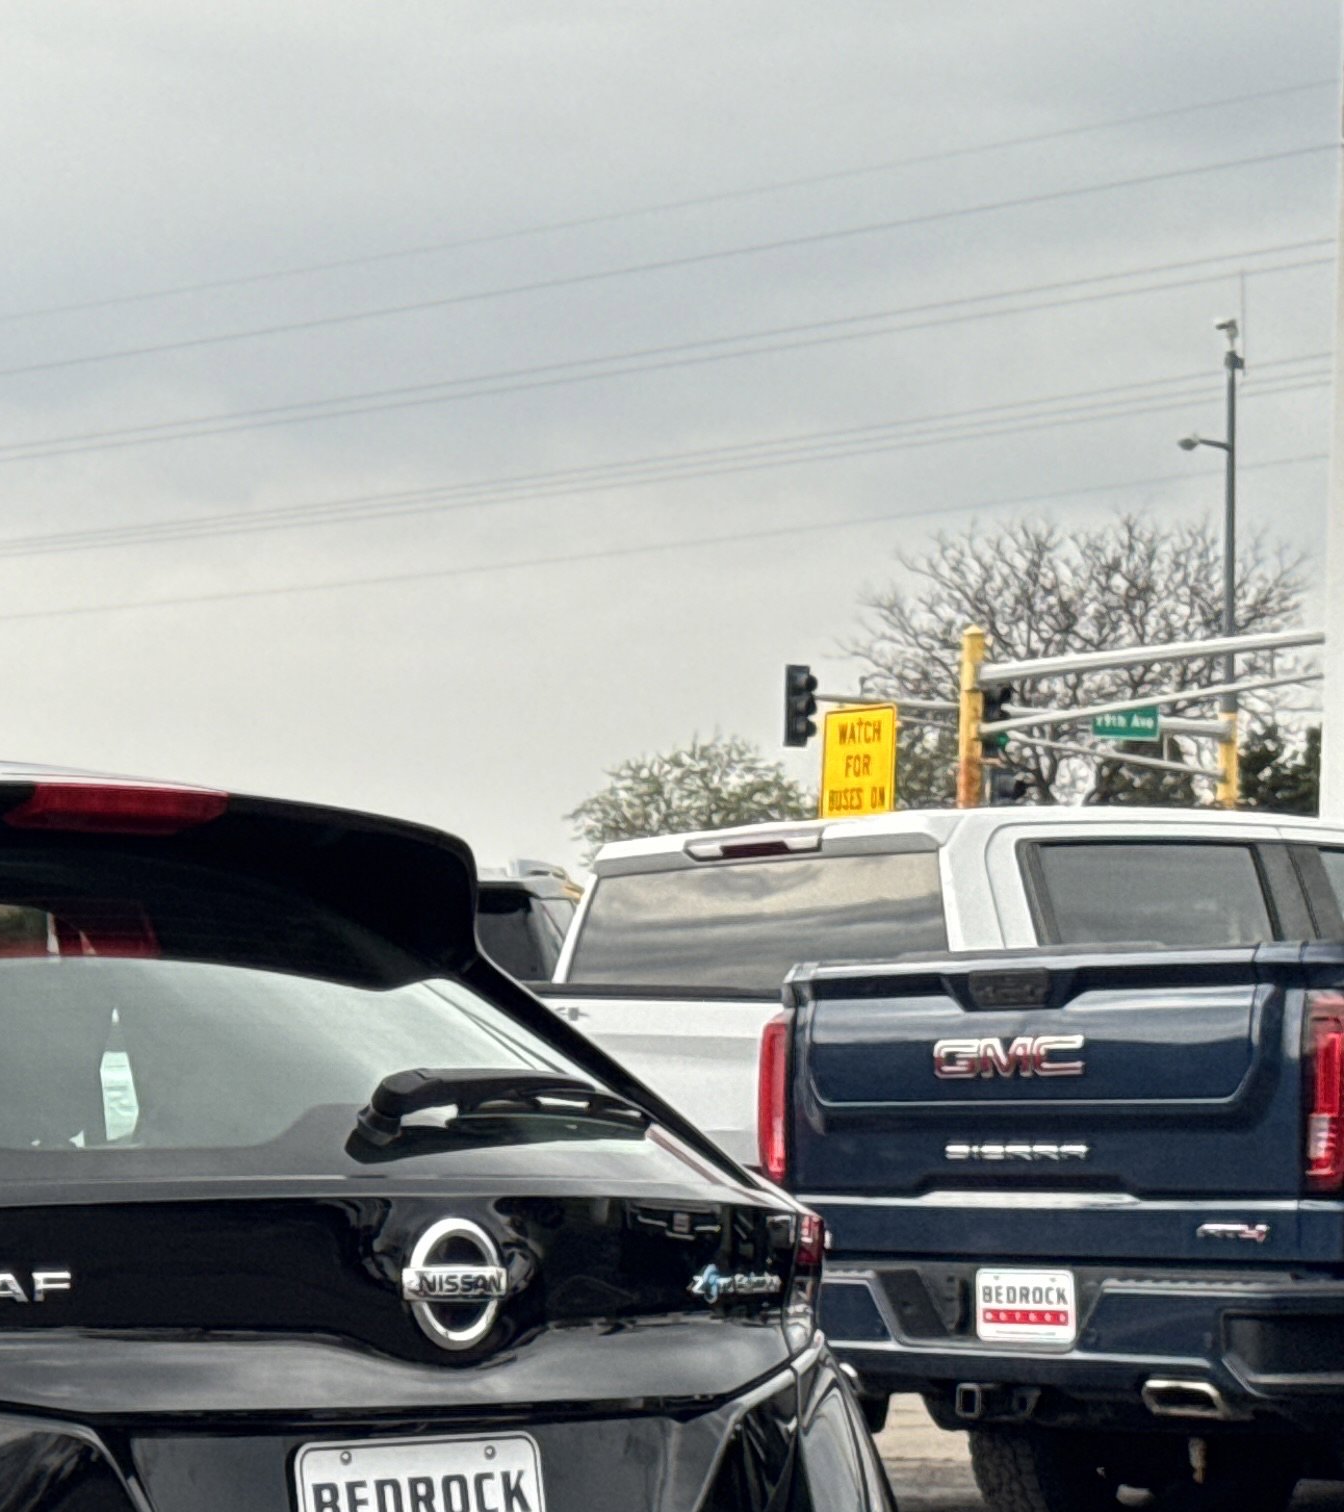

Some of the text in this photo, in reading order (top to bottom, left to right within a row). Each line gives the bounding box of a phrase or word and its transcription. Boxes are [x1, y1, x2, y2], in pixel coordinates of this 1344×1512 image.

[838, 719, 882, 745] WATCH
[1130, 713, 1155, 729] Ave
[844, 754, 872, 778] FOR
[828, 786, 886, 811] BUSES ON
[933, 1034, 1086, 1079] GMC
[418, 1272, 503, 1294] NISSAN
[982, 1285, 1069, 1305] BEDROCK
